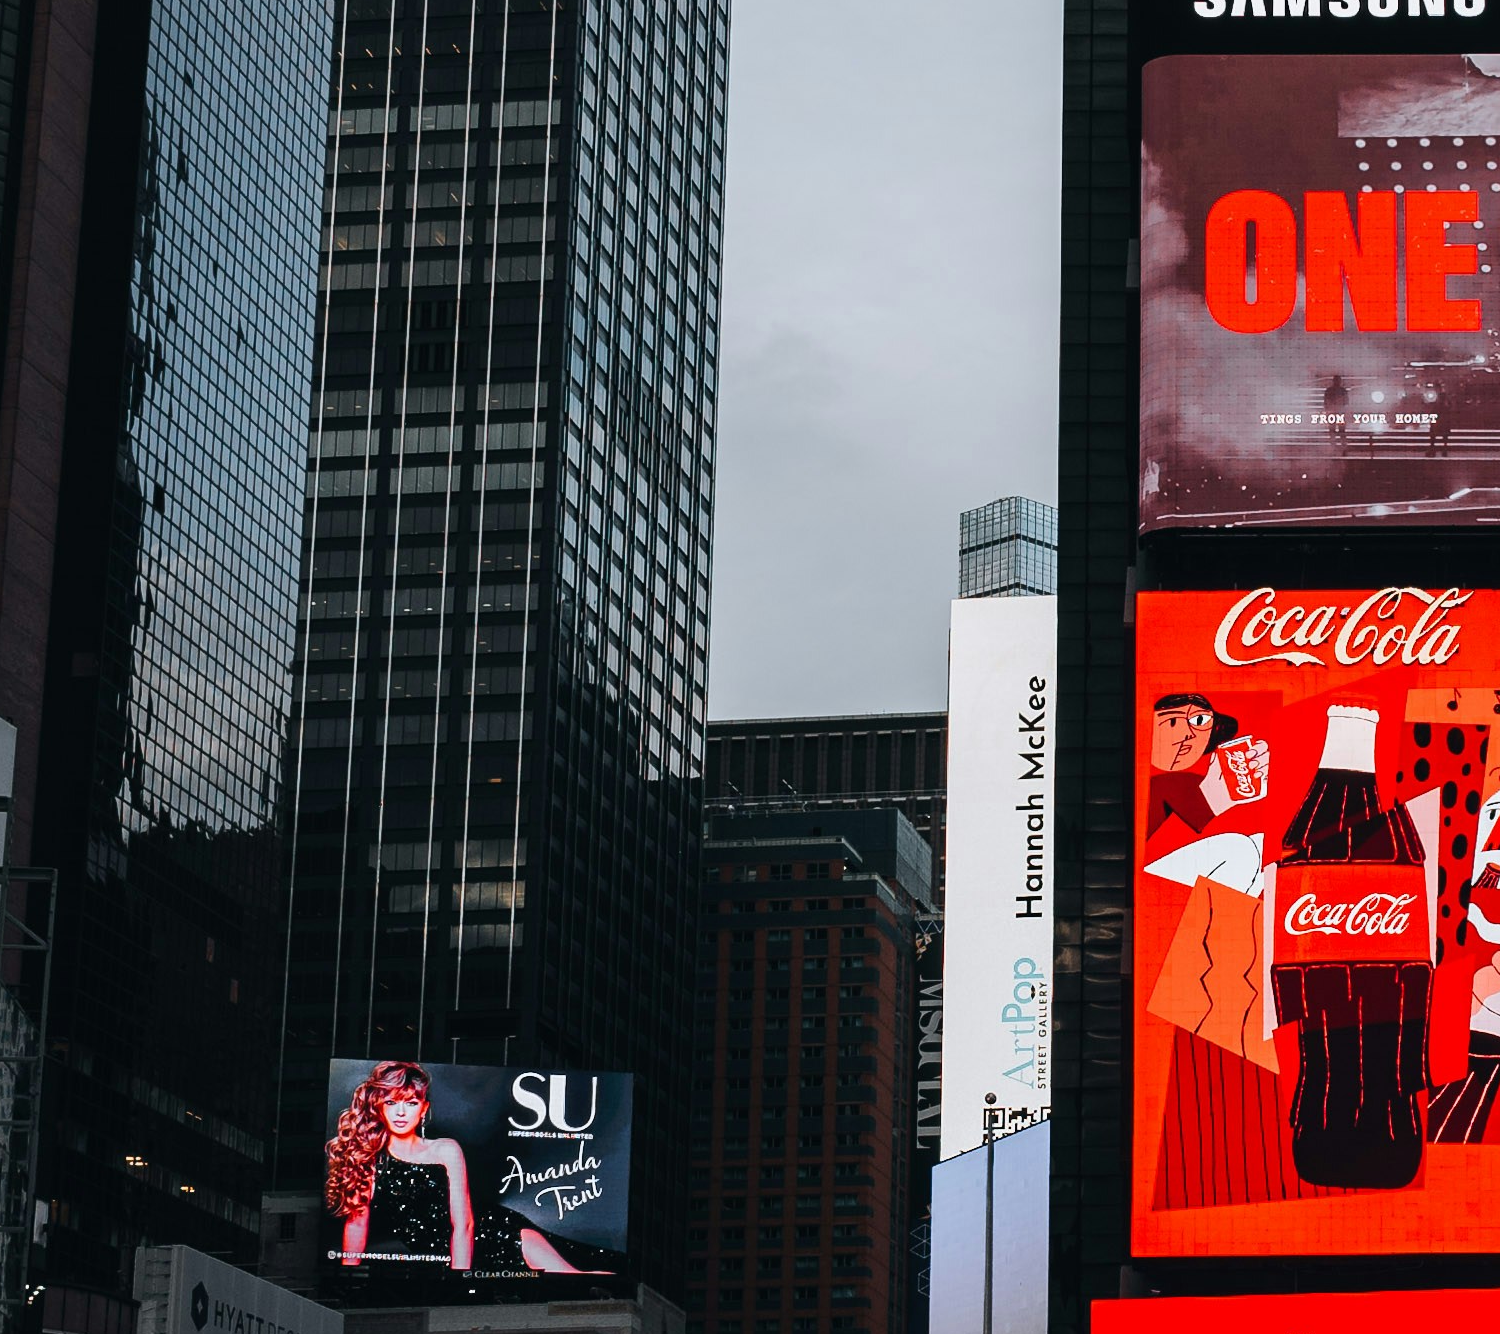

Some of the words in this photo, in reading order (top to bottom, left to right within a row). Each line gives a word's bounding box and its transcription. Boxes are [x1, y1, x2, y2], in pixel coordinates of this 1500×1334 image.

[1204, 188, 1482, 334] ONE
[1260, 413, 1302, 424] TINGS
[1311, 413, 1345, 424] FROM
[1354, 413, 1388, 424] YOUR
[1396, 413, 1439, 424] HOMET
[1213, 586, 1474, 667] Coca-Cola
[1017, 675, 1046, 778] McKee
[1017, 795, 1043, 919] Hannah
[1284, 892, 1418, 936] Coca-Cola
[1002, 957, 1036, 1089] ArtPop
[1039, 982, 1047, 1037] GALLERY
[1038, 1045, 1046, 1089] STREET
[508, 1072, 598, 1132] SU
[499, 1141, 602, 1194] Amanda
[534, 1177, 603, 1220] Trent
[474, 1270, 501, 1278] CLEAR
[502, 1269, 540, 1278] CHANNEL
